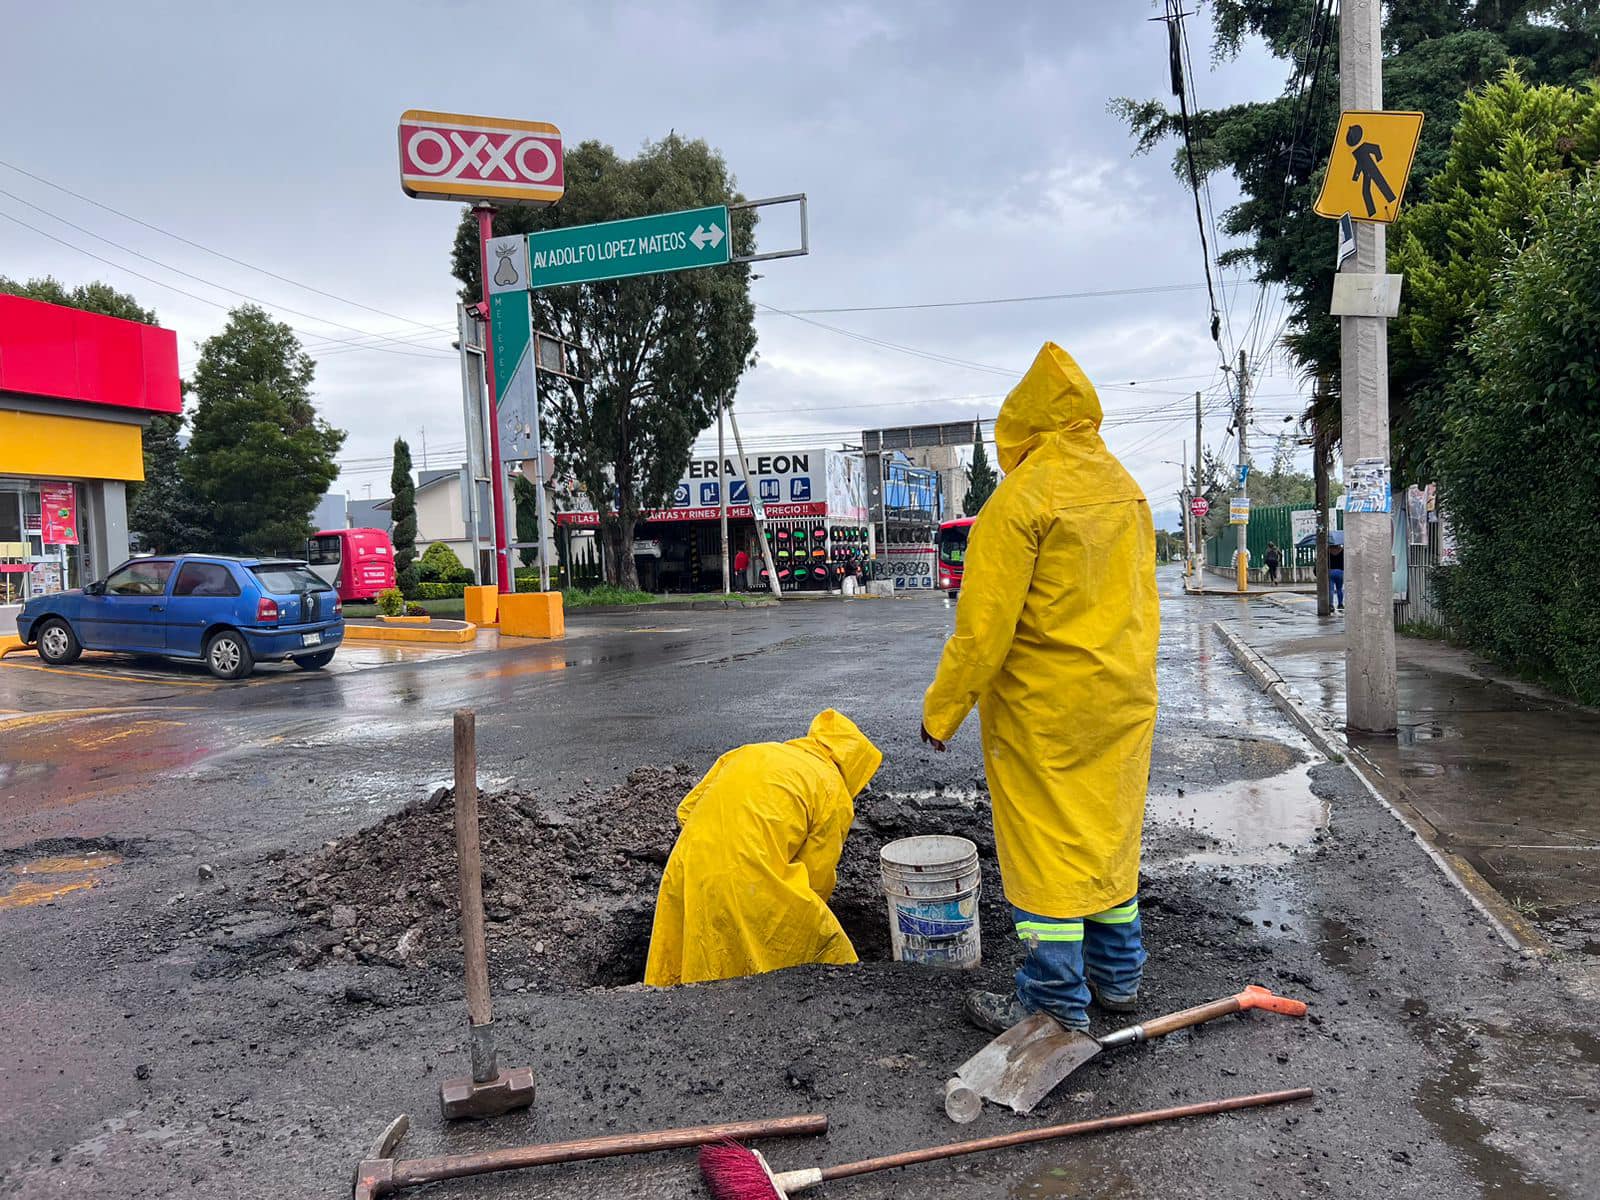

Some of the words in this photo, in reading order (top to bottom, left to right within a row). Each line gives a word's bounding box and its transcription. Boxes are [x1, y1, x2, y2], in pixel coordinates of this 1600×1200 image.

[407, 130, 556, 182] OXXO
[548, 243, 596, 267] ADOLFO
[597, 238, 636, 261] LOPEZ
[639, 231, 687, 255] MATEOS
[688, 510, 716, 519] RINES
[766, 505, 801, 515] PRECIO
